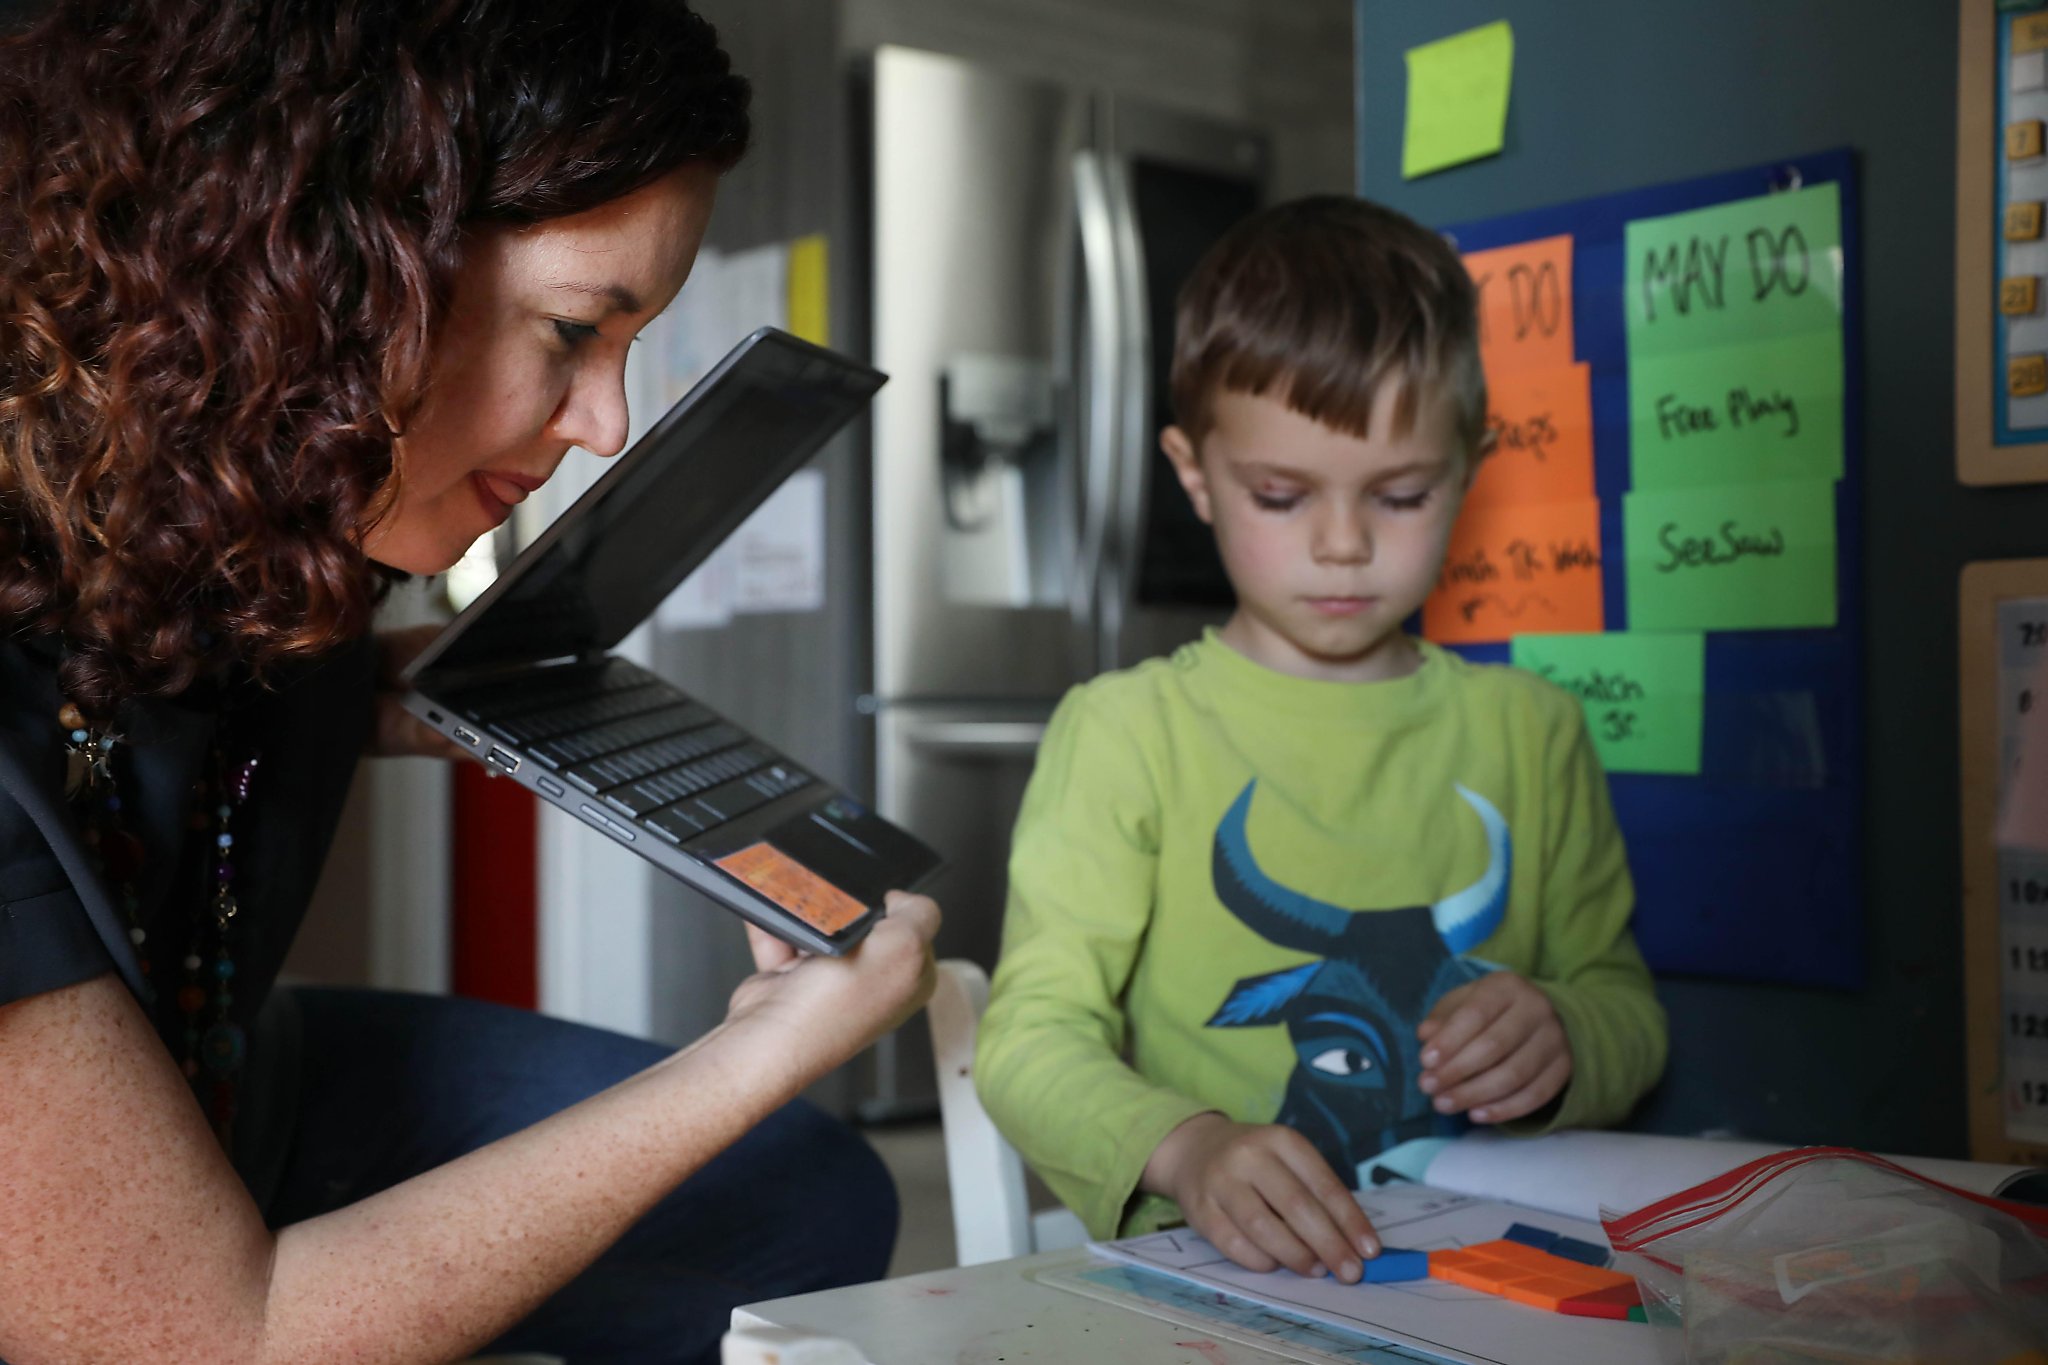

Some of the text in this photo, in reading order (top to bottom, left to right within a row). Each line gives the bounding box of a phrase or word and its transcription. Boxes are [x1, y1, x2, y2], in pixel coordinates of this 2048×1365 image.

[1507, 260, 1562, 342] DO
[1642, 224, 1810, 323] MAY DO
[1655, 385, 1800, 441] Free Play
